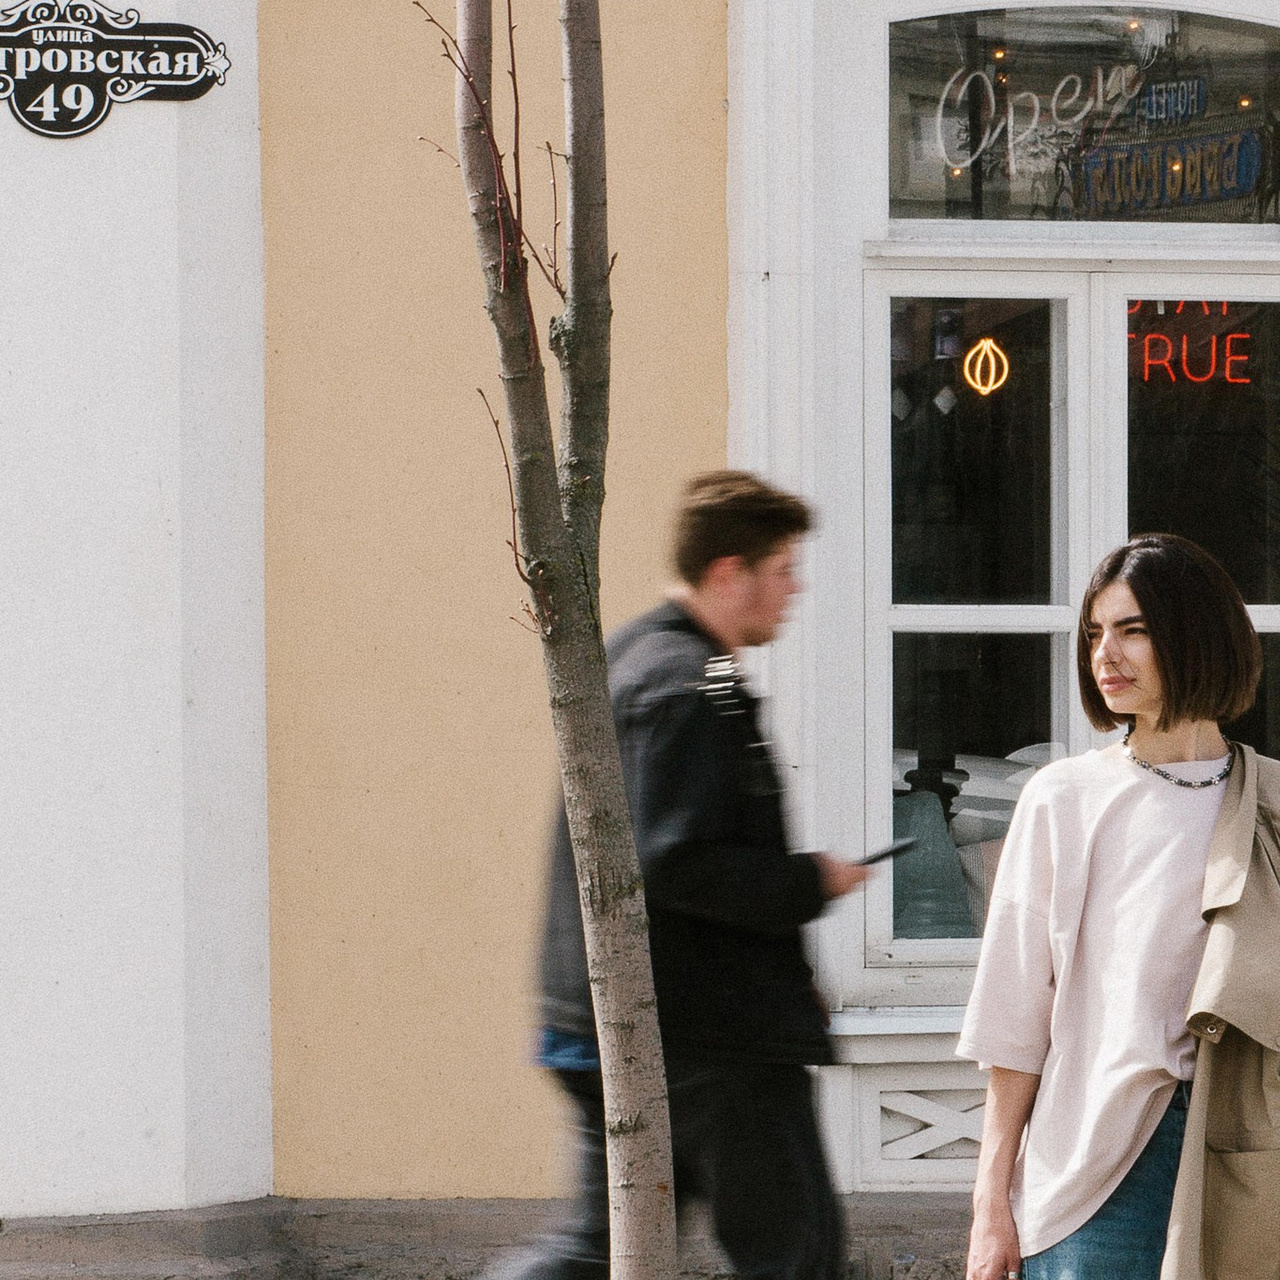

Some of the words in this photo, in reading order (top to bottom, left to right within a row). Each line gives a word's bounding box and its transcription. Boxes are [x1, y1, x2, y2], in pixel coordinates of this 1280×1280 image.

[32, 29, 93, 45] улица
[25, 83, 95, 123] 49
[937, 64, 1142, 176] Open
[1127, 332, 1251, 384] RUE
